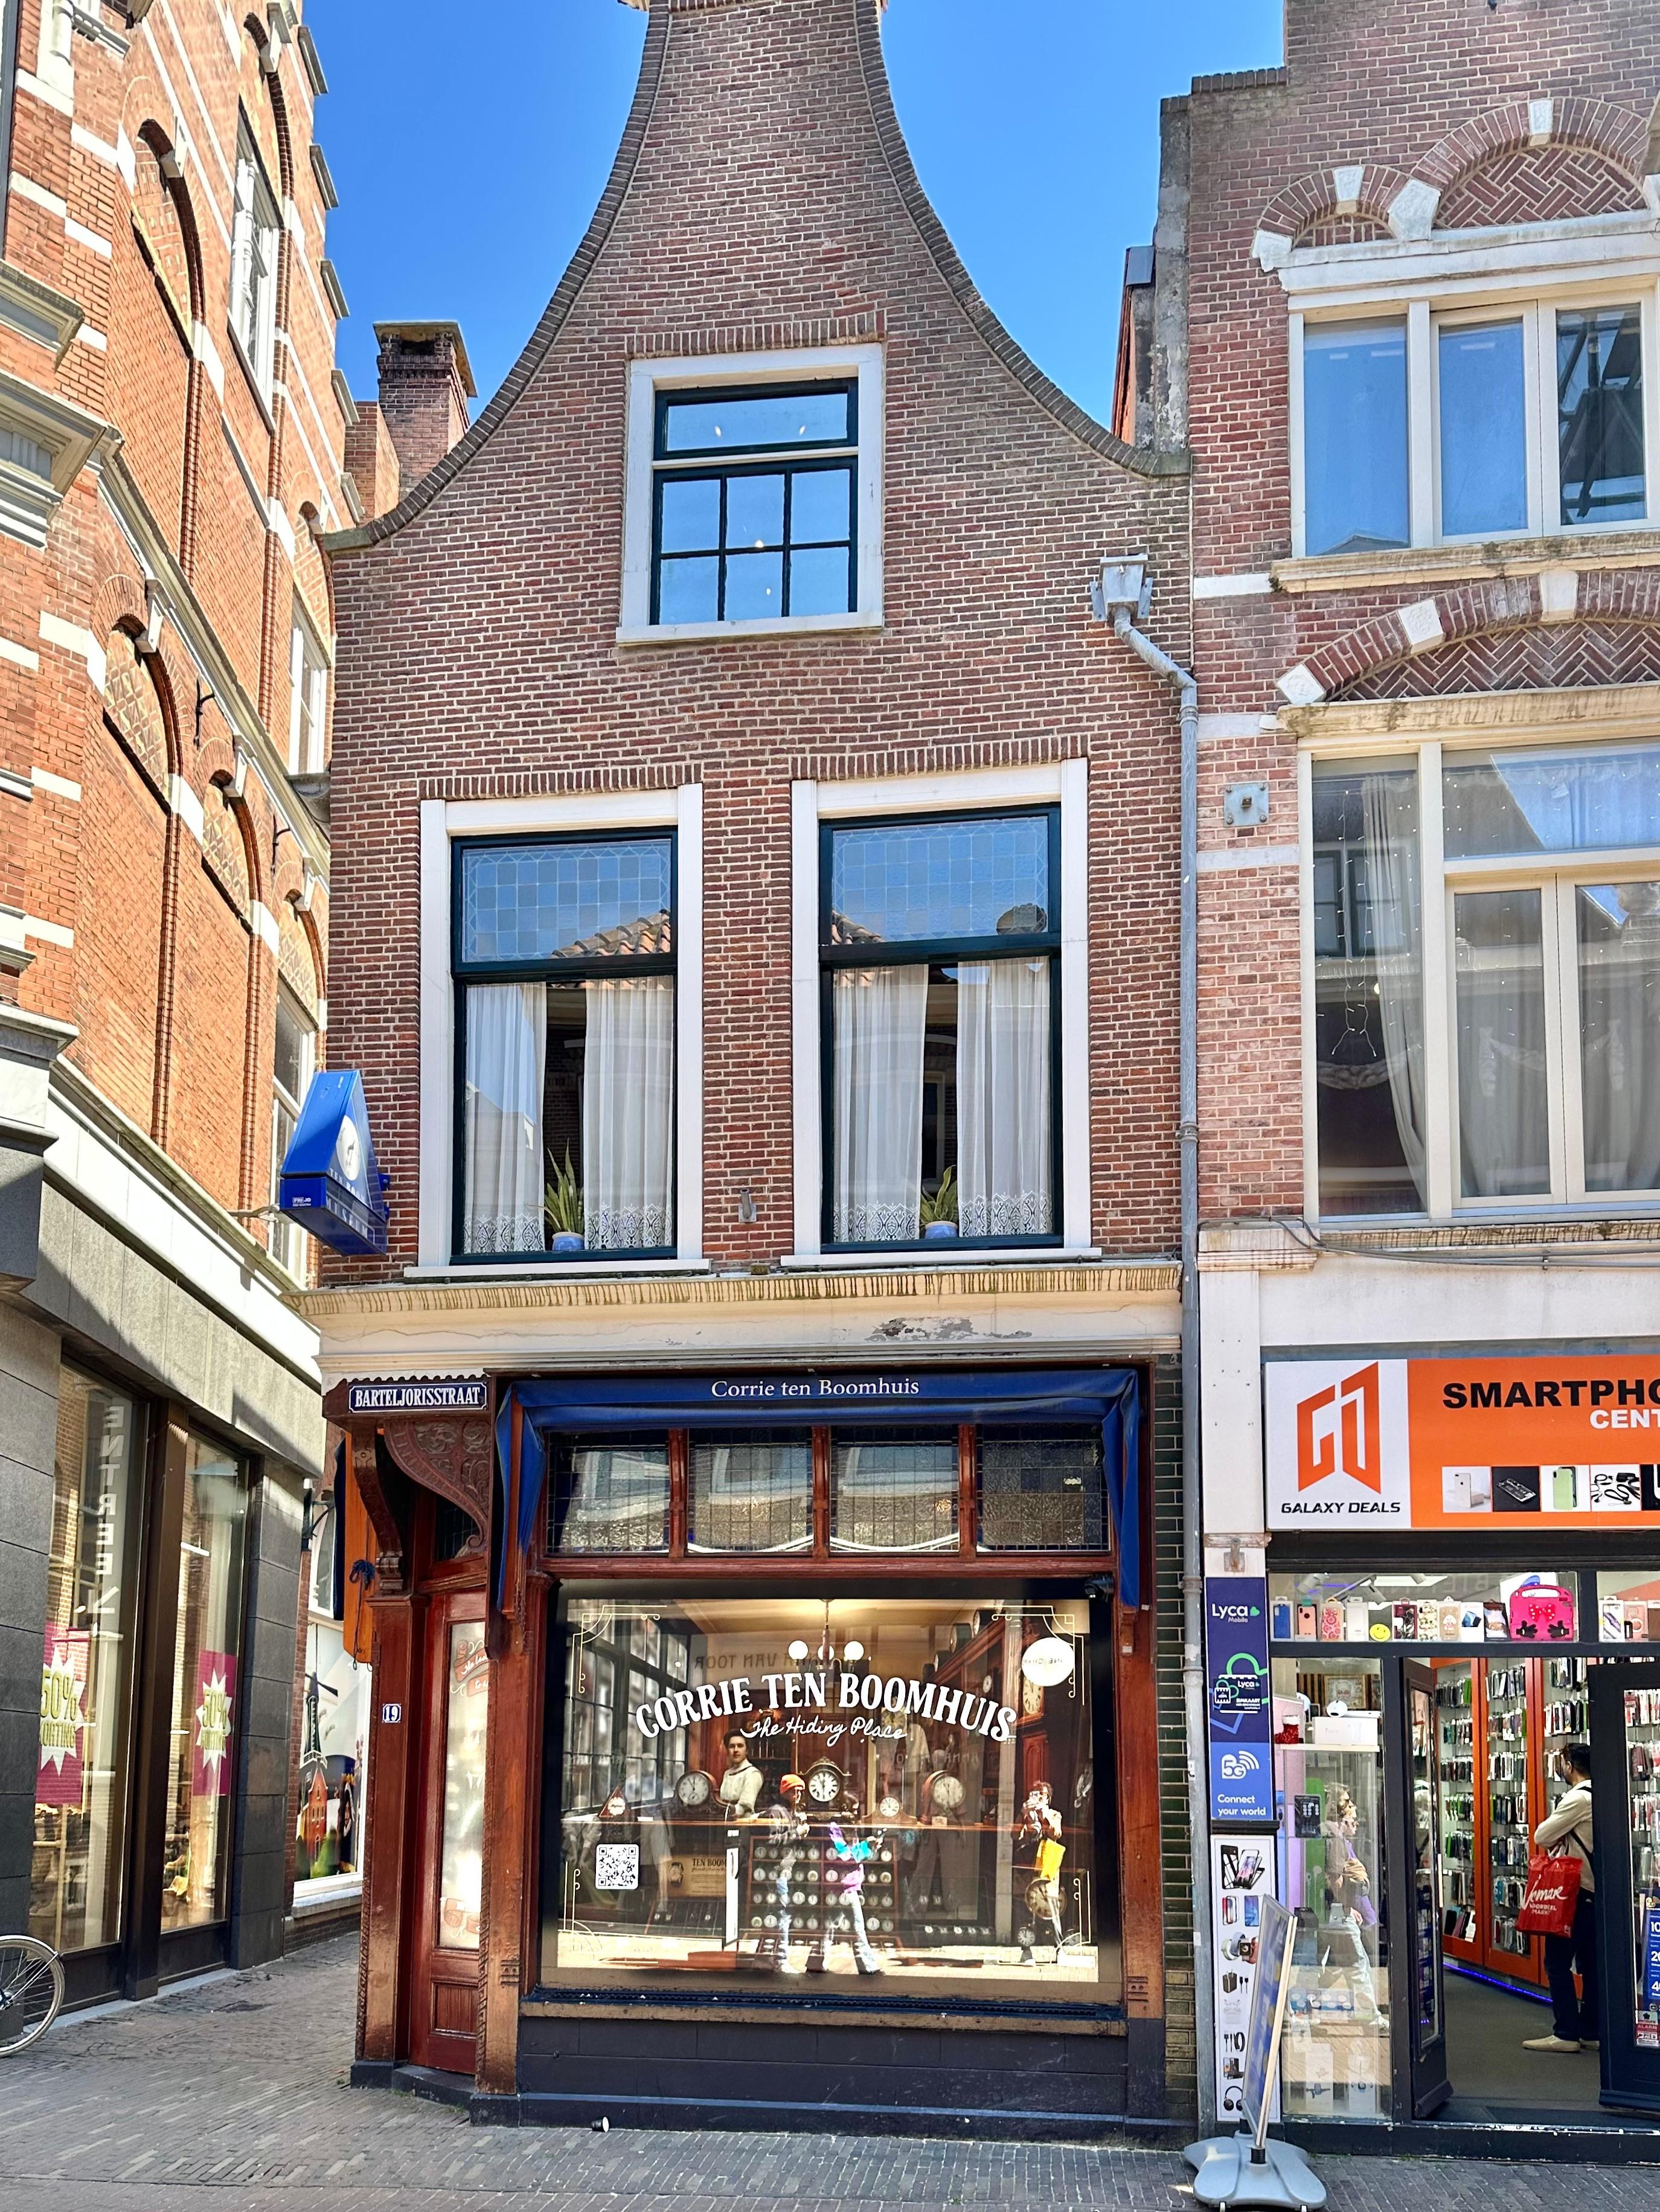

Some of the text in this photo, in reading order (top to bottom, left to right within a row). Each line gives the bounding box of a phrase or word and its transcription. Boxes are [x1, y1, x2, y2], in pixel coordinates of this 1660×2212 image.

[355, 1387, 480, 1407] BARTELJORISSTRAAT
[711, 1378, 919, 1397] Corrie ten Boomhuis
[1281, 1502, 1400, 1514] GALAXY DEALS
[1212, 1603, 1248, 1619] Lyca
[40, 1670, 78, 1721] 50%
[202, 1689, 226, 1730] 50%
[385, 1705, 398, 1721] 19
[636, 1672, 1017, 1742] CORRIE TEN BOOMHUIS
[39, 1721, 76, 1748] ORTING
[740, 1715, 908, 1747] The Hiding Place
[1217, 1794, 1255, 1803] Connect
[1218, 1807, 1266, 1817] your world
[1652, 1981, 1660, 1992] 4
